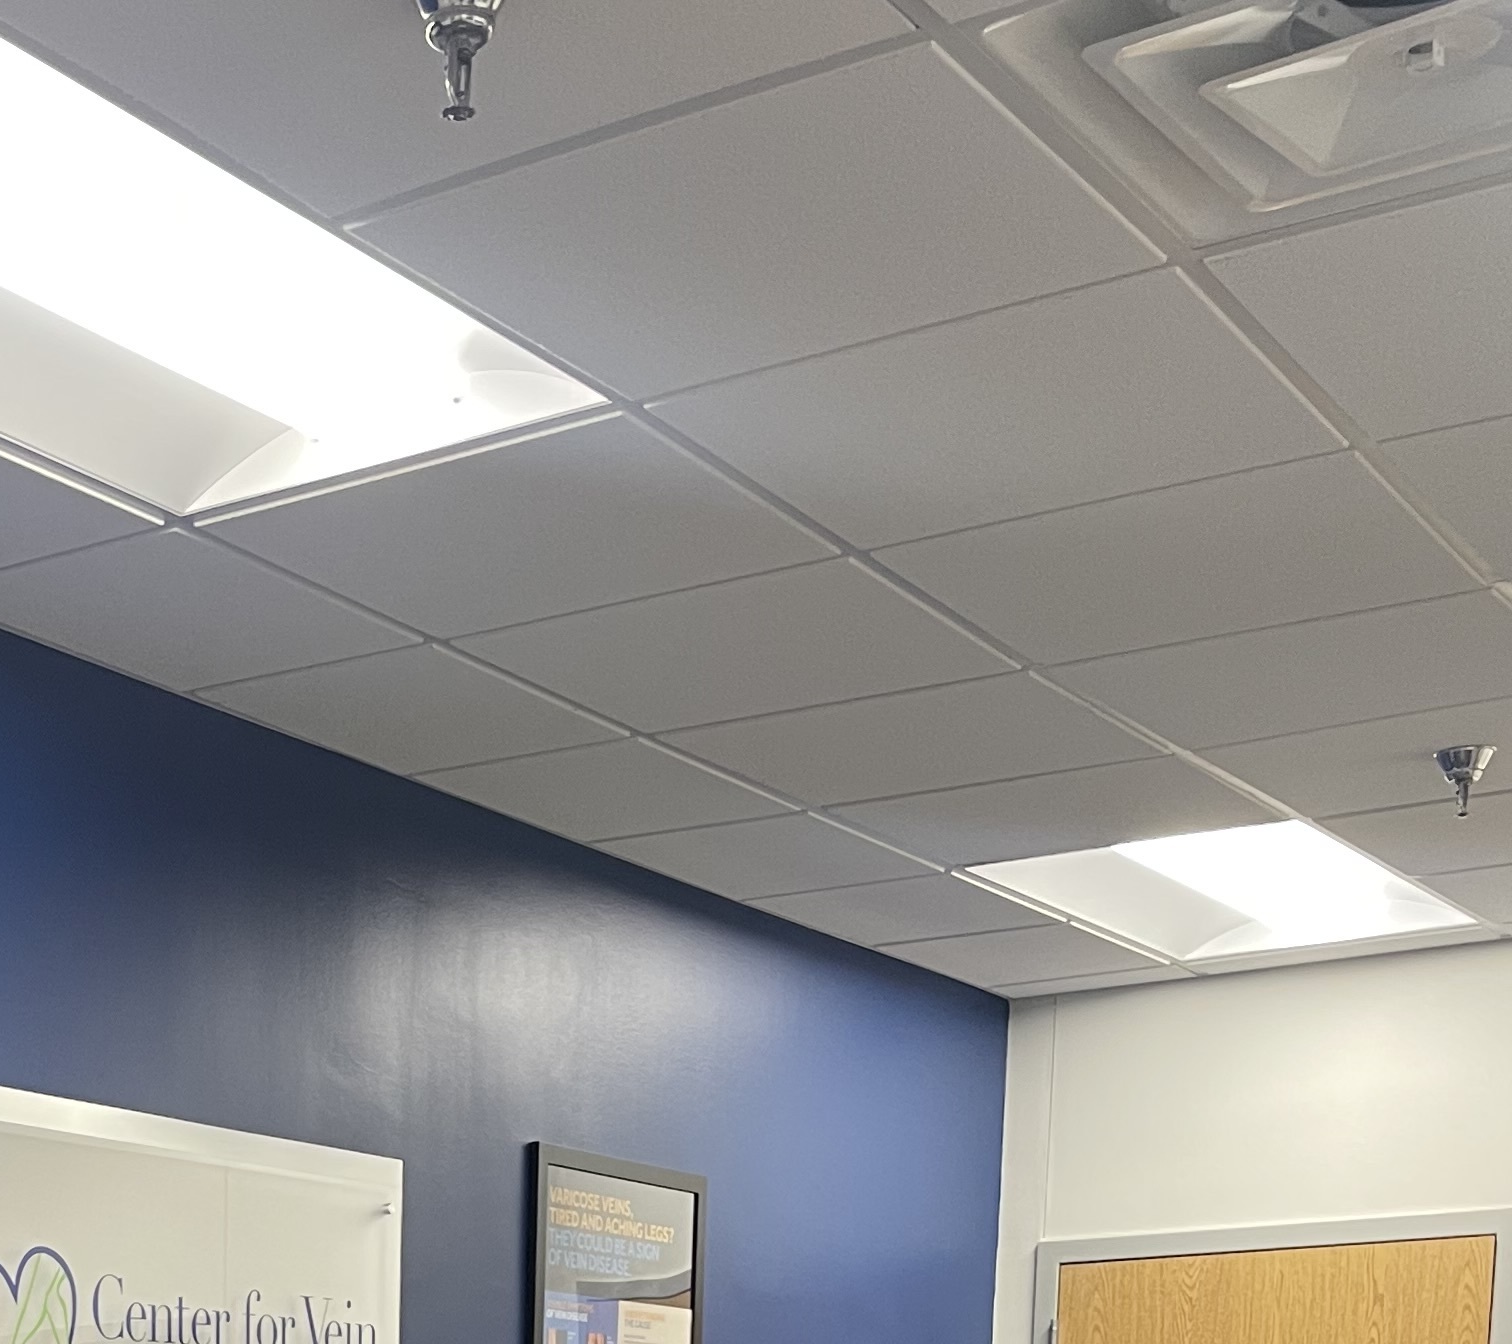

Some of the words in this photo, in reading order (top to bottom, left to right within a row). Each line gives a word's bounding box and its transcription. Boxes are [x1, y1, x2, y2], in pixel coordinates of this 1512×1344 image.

[549, 1185, 600, 1211] VARICOSE
[601, 1196, 634, 1219] VEINS,
[549, 1206, 580, 1228] TIRED
[580, 1212, 604, 1232] AND
[604, 1217, 643, 1239] ACHING
[644, 1223, 675, 1244] LEGS?
[548, 1227, 576, 1247] THEY
[577, 1232, 613, 1253] COULD
[614, 1238, 626, 1256] BE
[628, 1241, 636, 1258] A
[636, 1242, 661, 1261] SIGN
[548, 1248, 561, 1265] OF
[564, 1251, 588, 1270] VEIN
